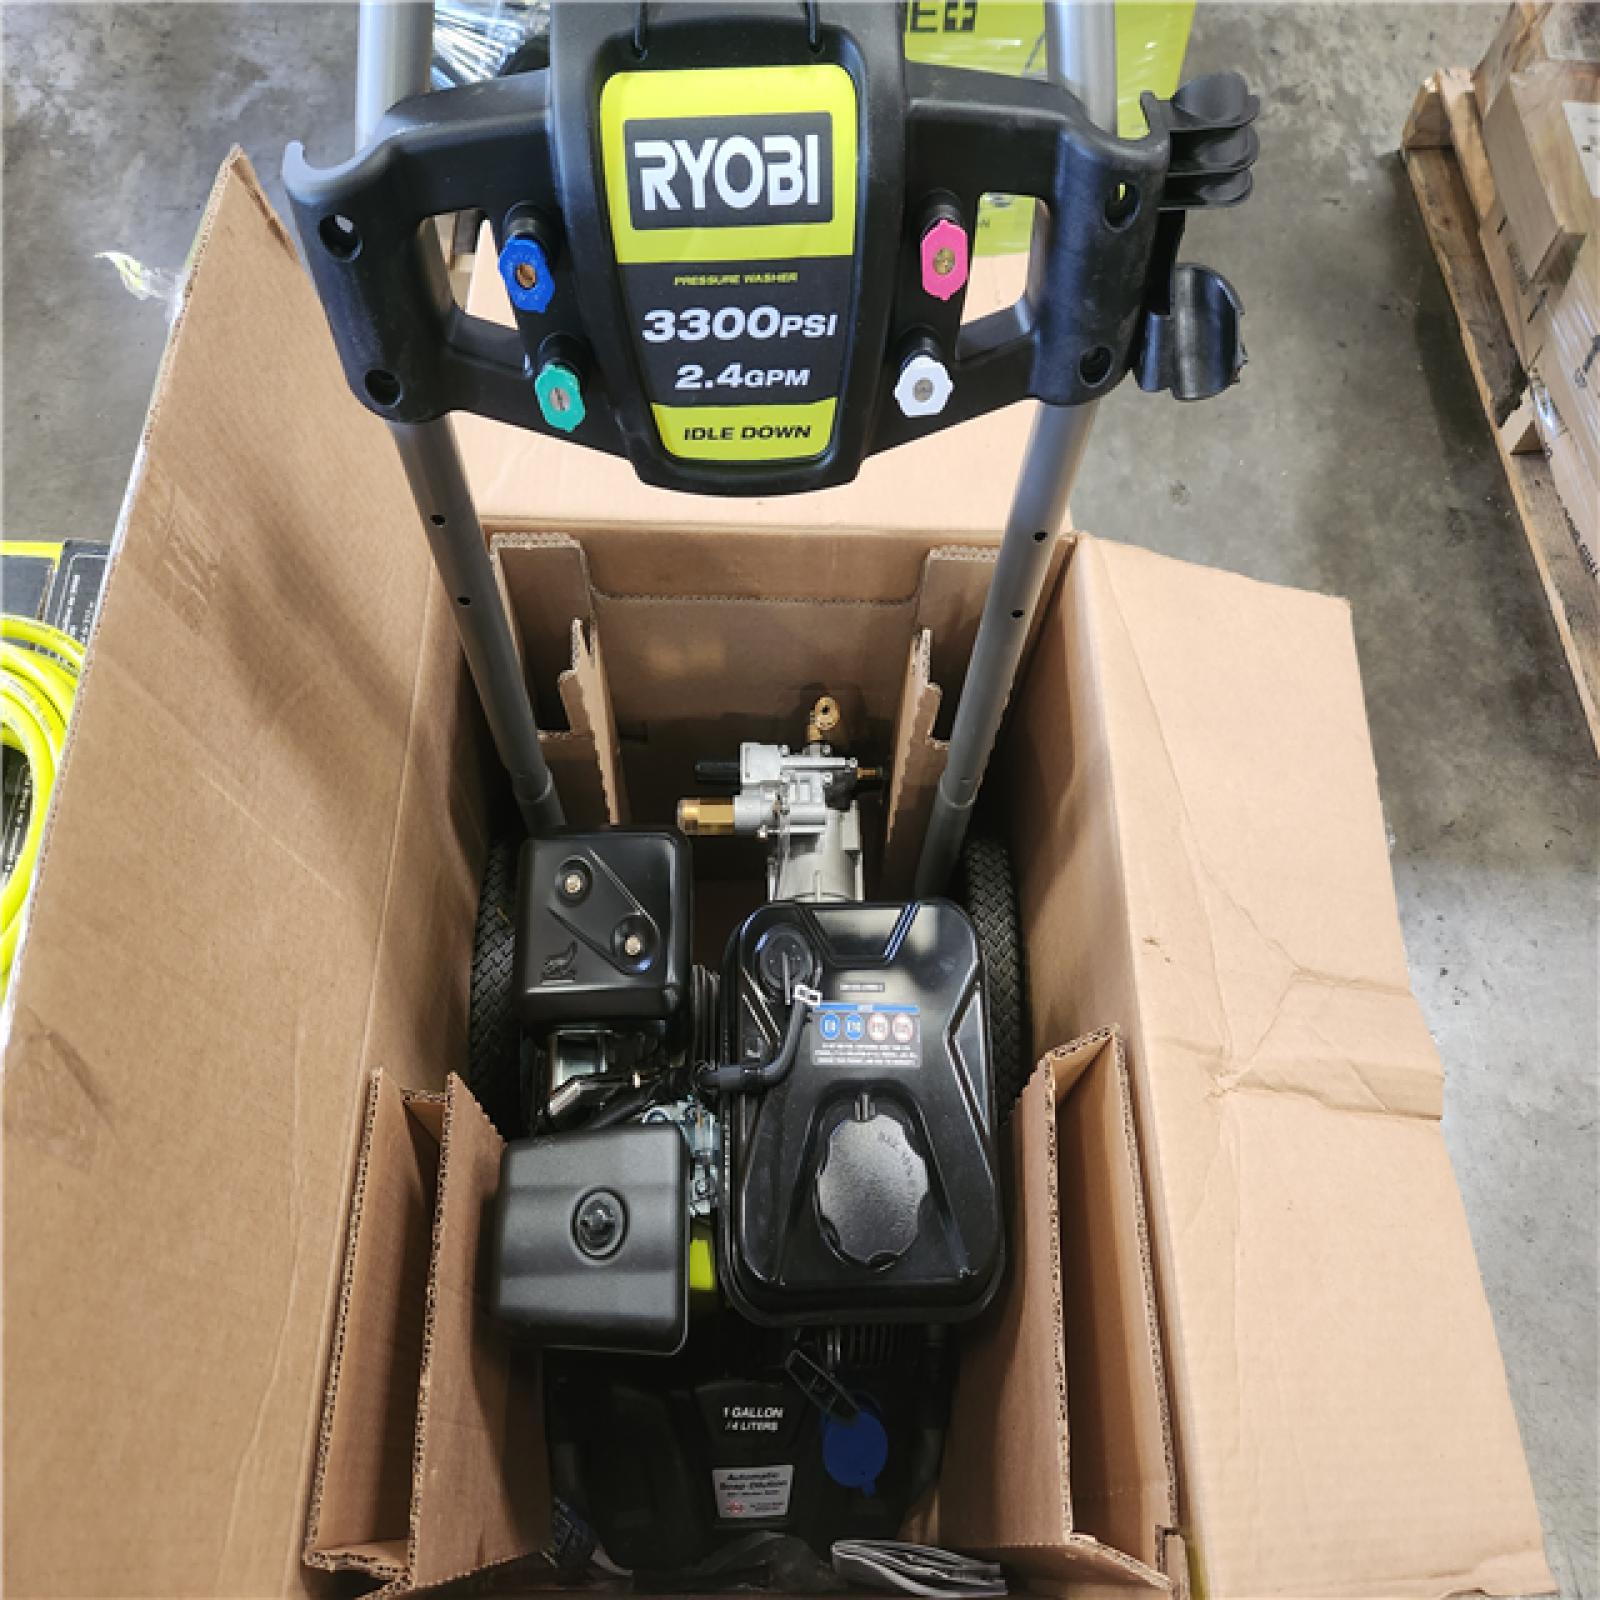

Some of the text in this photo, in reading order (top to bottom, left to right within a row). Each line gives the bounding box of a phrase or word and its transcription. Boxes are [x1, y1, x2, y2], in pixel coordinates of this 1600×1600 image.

[634, 134, 820, 211] RYOBI
[674, 272, 798, 286] PRESSURE WASHER
[642, 306, 839, 342] 3300PSI
[674, 362, 811, 390] 2.4GPM
[684, 424, 811, 441] IDLE DOWN
[723, 1406, 783, 1418] 1 GALLON
[741, 1421, 779, 1431] LITERS
